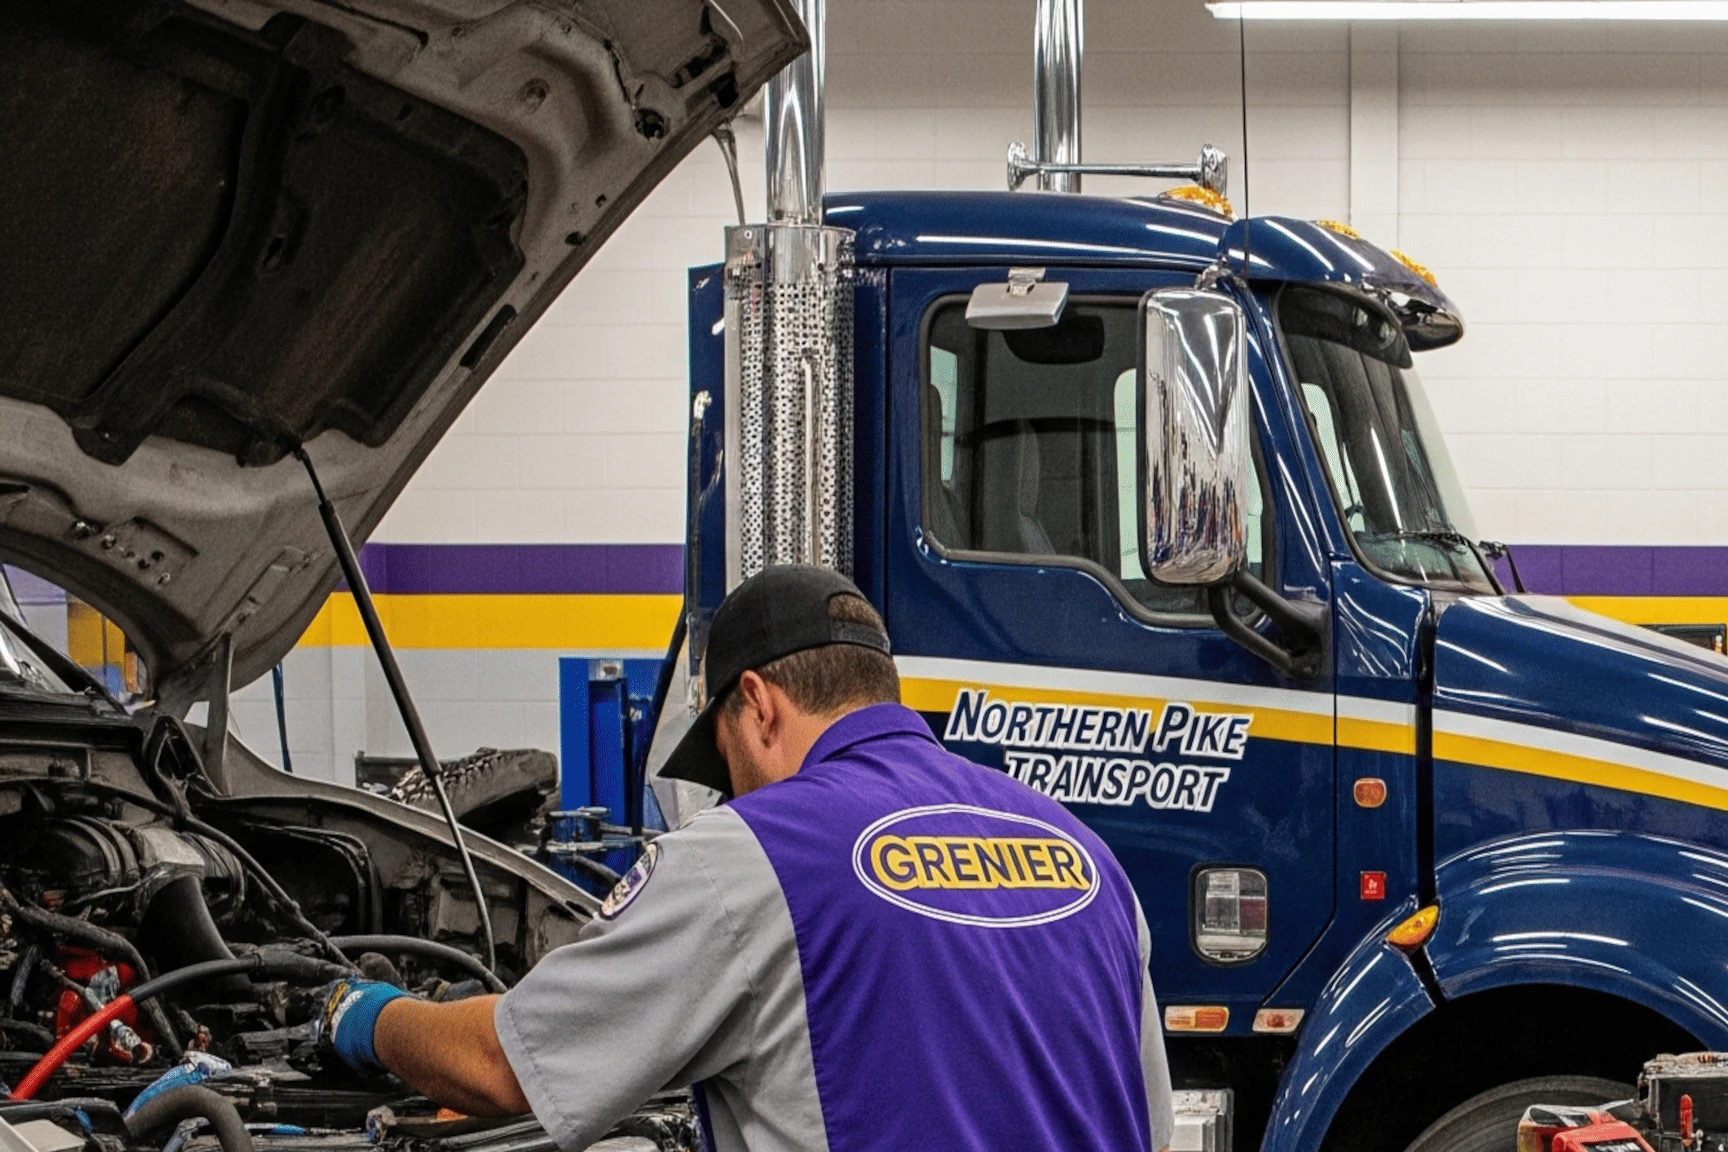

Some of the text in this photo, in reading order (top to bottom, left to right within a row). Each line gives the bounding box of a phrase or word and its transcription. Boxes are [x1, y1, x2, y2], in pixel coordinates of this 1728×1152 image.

[945, 689, 1253, 759] NORTHERN PIKE
[1005, 752, 1230, 812] TRANSPORT
[876, 840, 1087, 888] GRENIER
